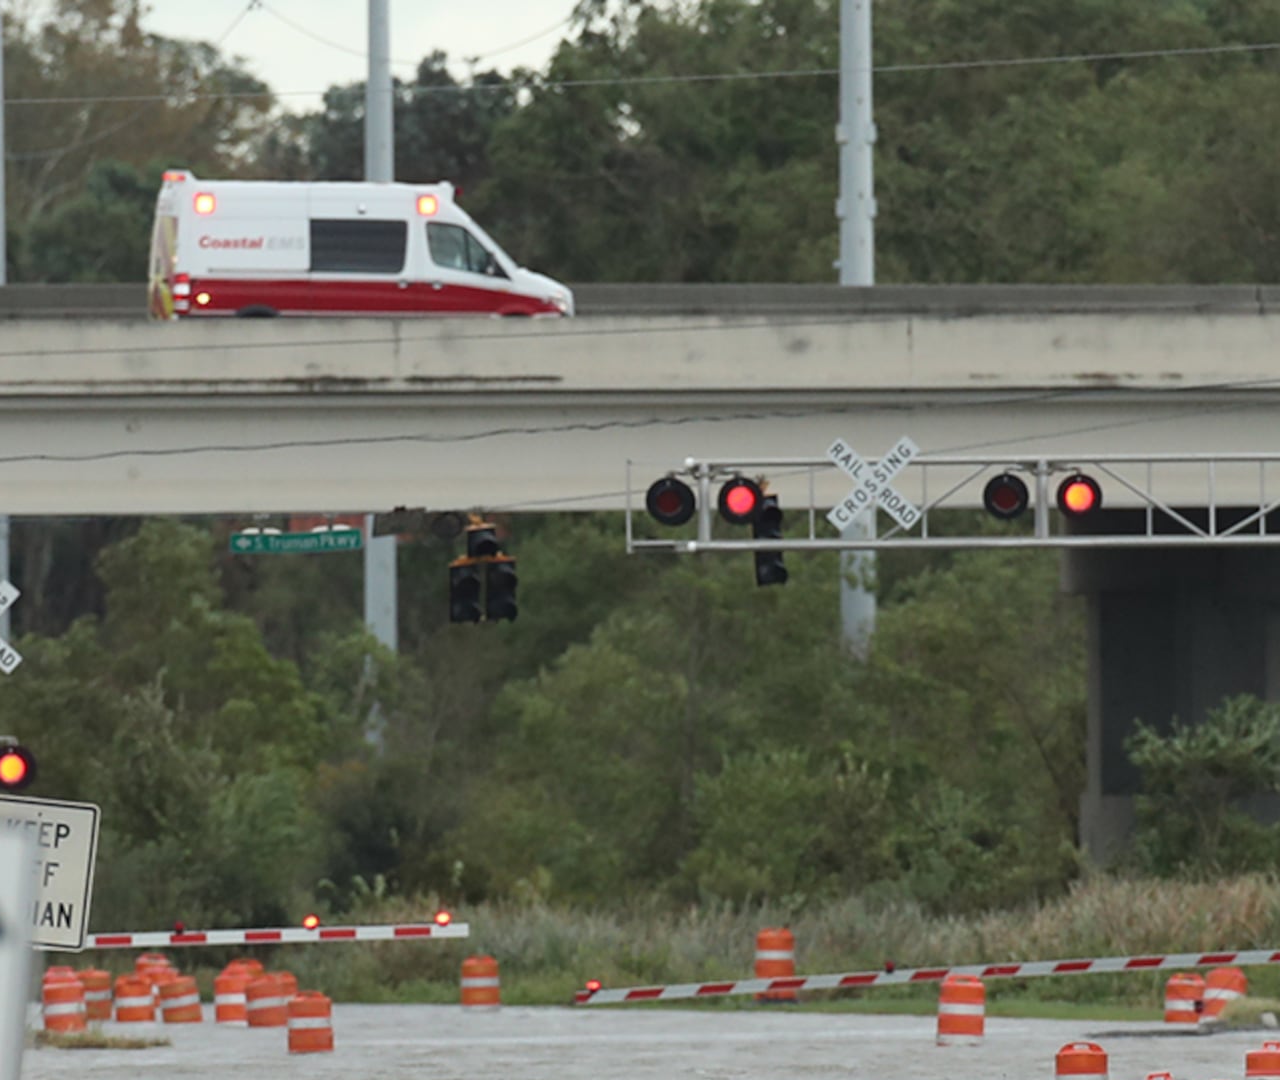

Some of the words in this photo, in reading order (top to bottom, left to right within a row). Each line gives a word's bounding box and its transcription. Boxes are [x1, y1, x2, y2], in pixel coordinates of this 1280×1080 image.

[198, 236, 264, 249] Coastal
[829, 443, 863, 479] RAIL
[880, 488, 916, 524] ROAD
[835, 443, 911, 523] CROSSING
[320, 533, 357, 549] Pkwy
